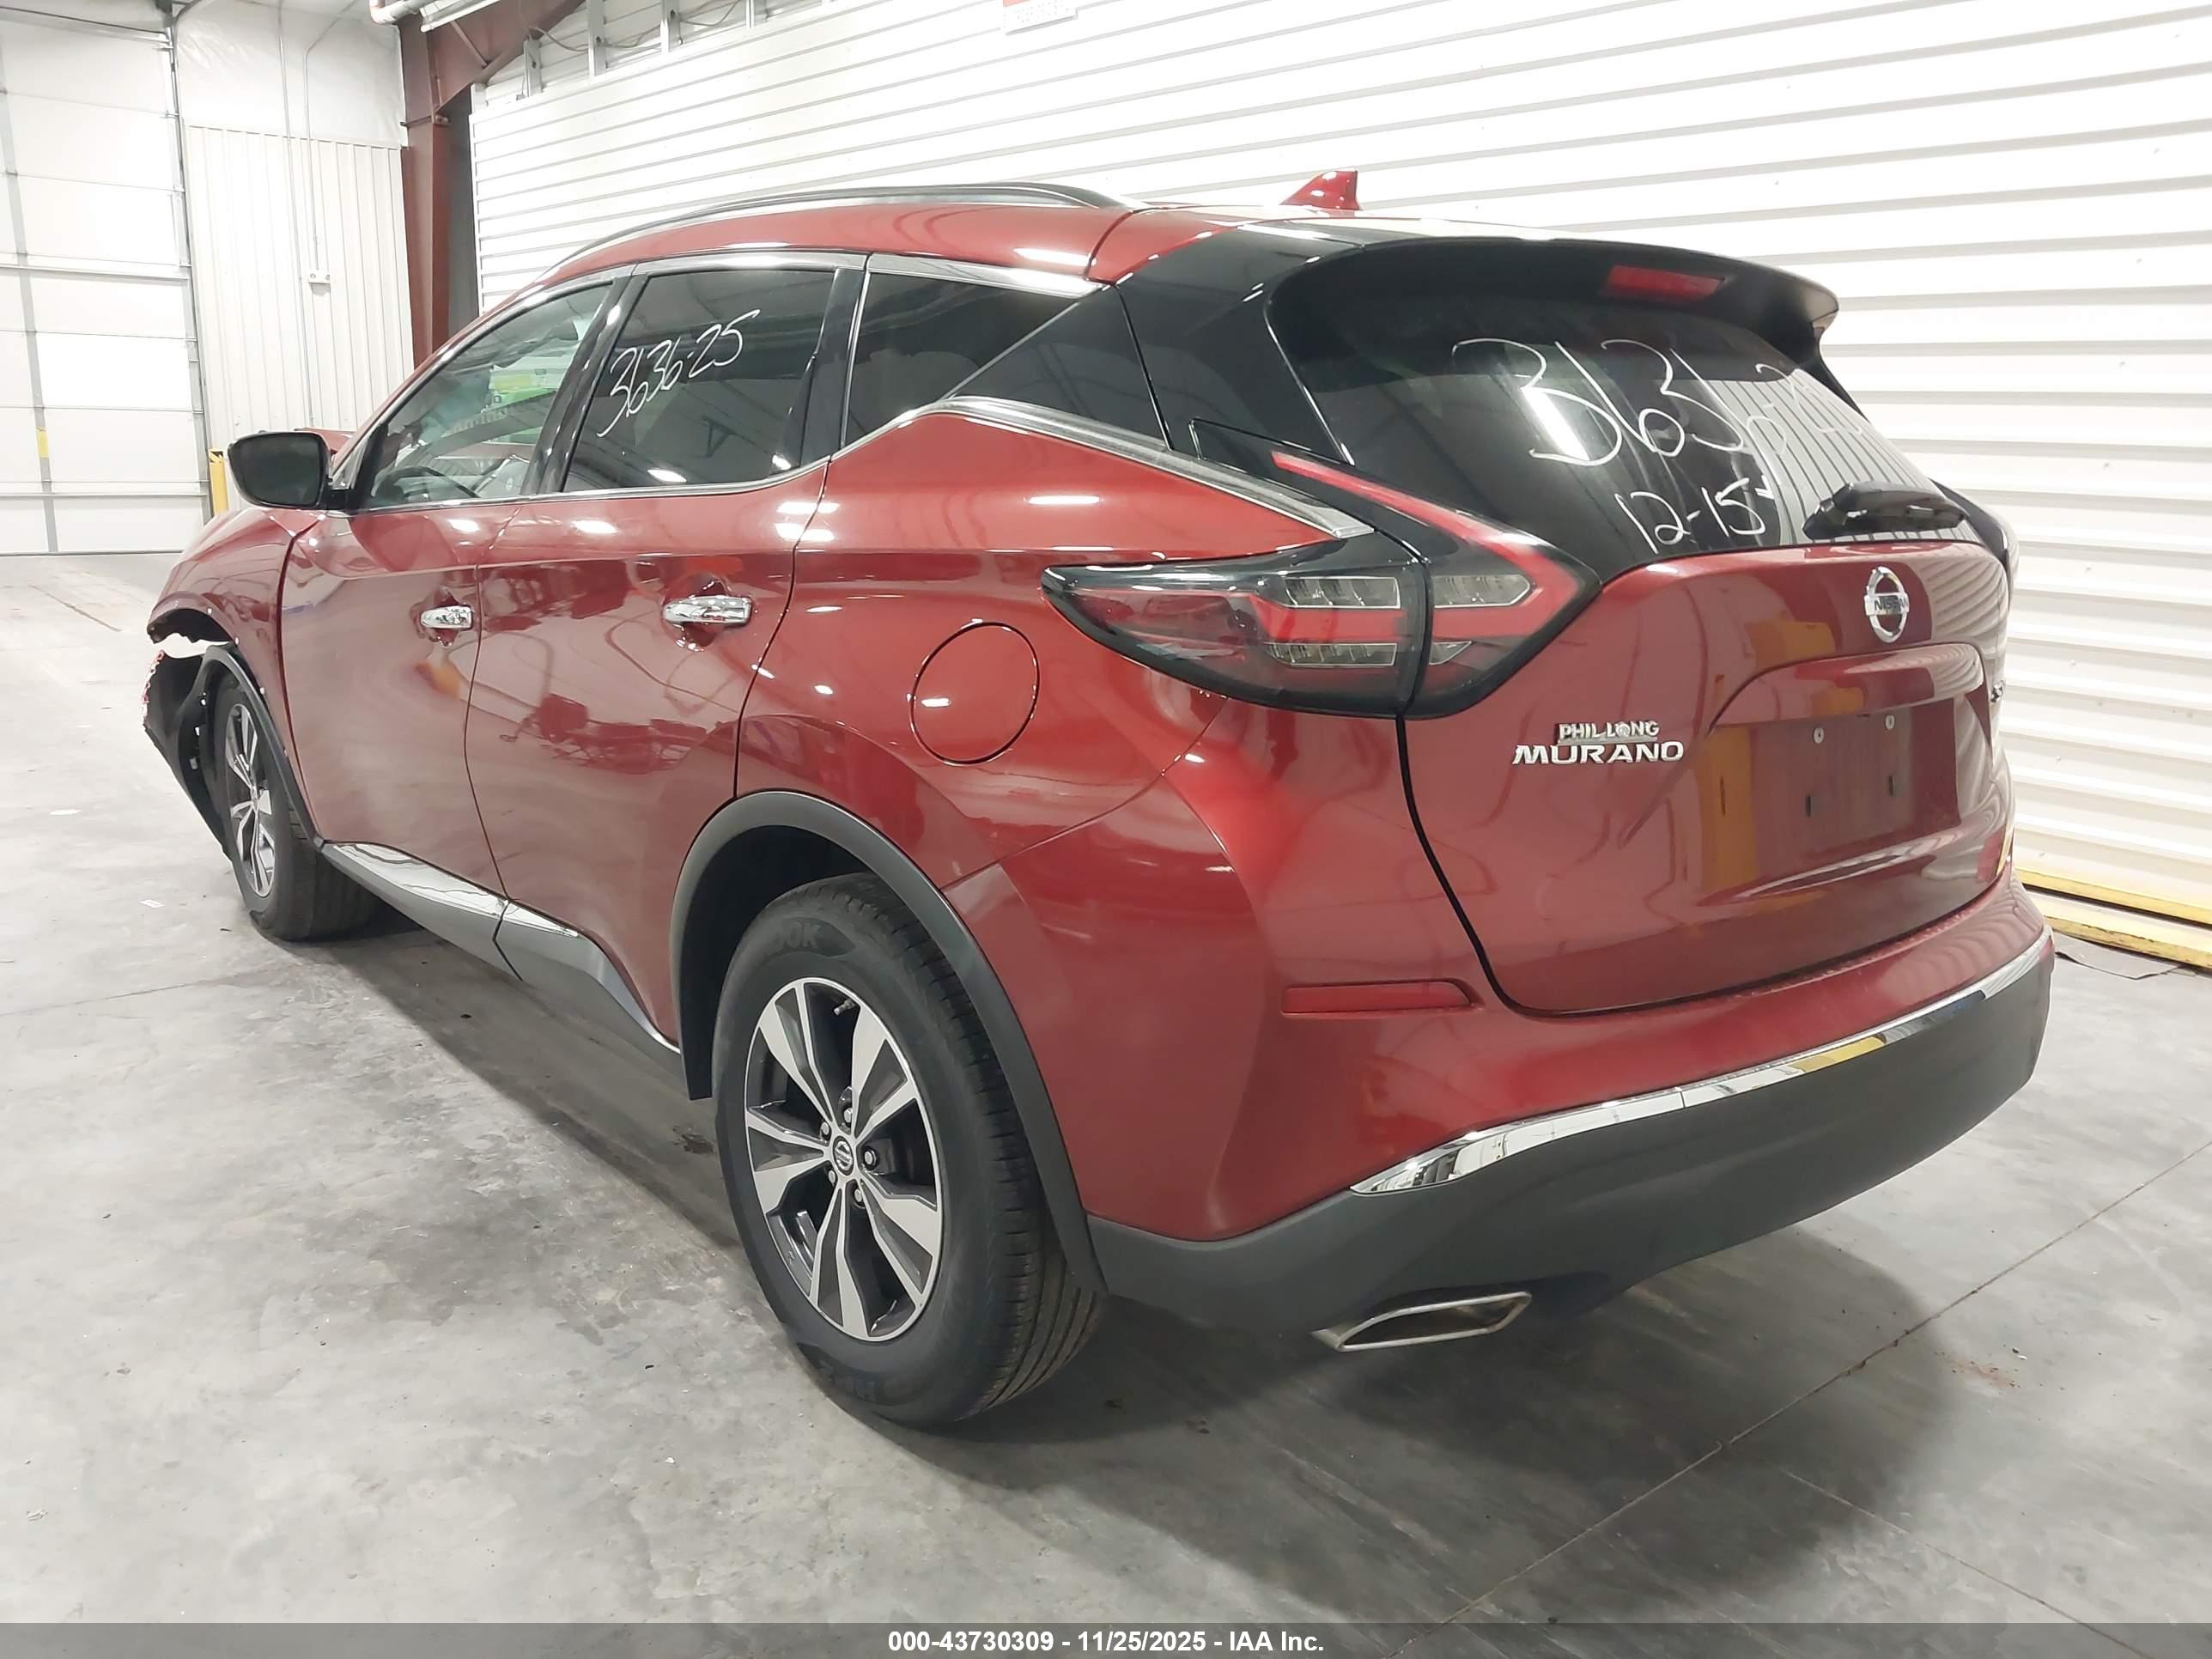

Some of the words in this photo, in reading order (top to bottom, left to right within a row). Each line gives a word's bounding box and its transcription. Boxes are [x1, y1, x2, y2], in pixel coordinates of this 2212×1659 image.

[596, 309, 761, 437] 3636-25
[1559, 722, 1606, 739] PHIL
[1607, 720, 1660, 738] LONG
[1512, 741, 1684, 765] MURANO
